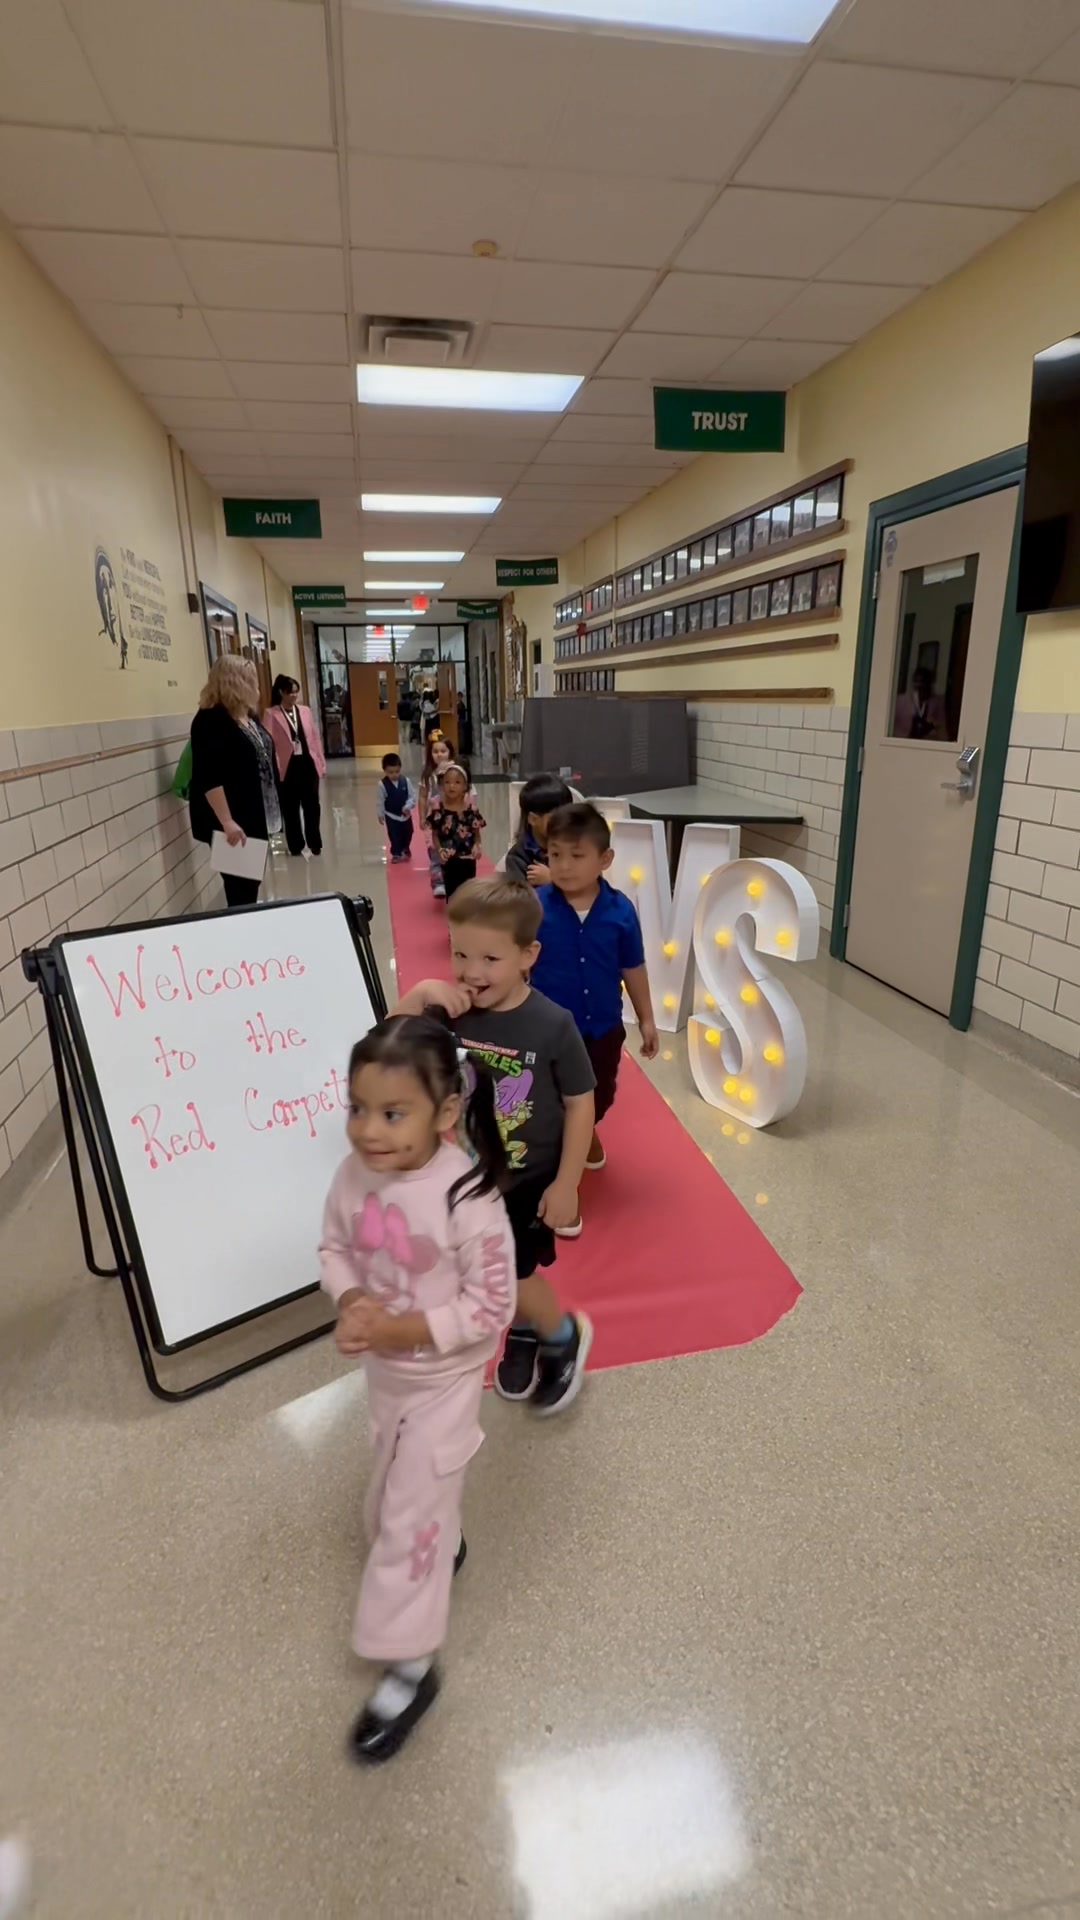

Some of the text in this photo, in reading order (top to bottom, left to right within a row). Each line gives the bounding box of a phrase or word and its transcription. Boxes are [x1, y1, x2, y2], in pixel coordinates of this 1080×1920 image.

[691, 411, 748, 431] TRUST
[255, 512, 292, 525] FAITH
[497, 567, 557, 577] RESPECT FOR OTHERS
[294, 592, 345, 601] ACTIVE LISTENING
[86, 944, 305, 1017] Welcome
[154, 1011, 307, 1077] to the
[131, 1068, 348, 1169] Red Carpet
